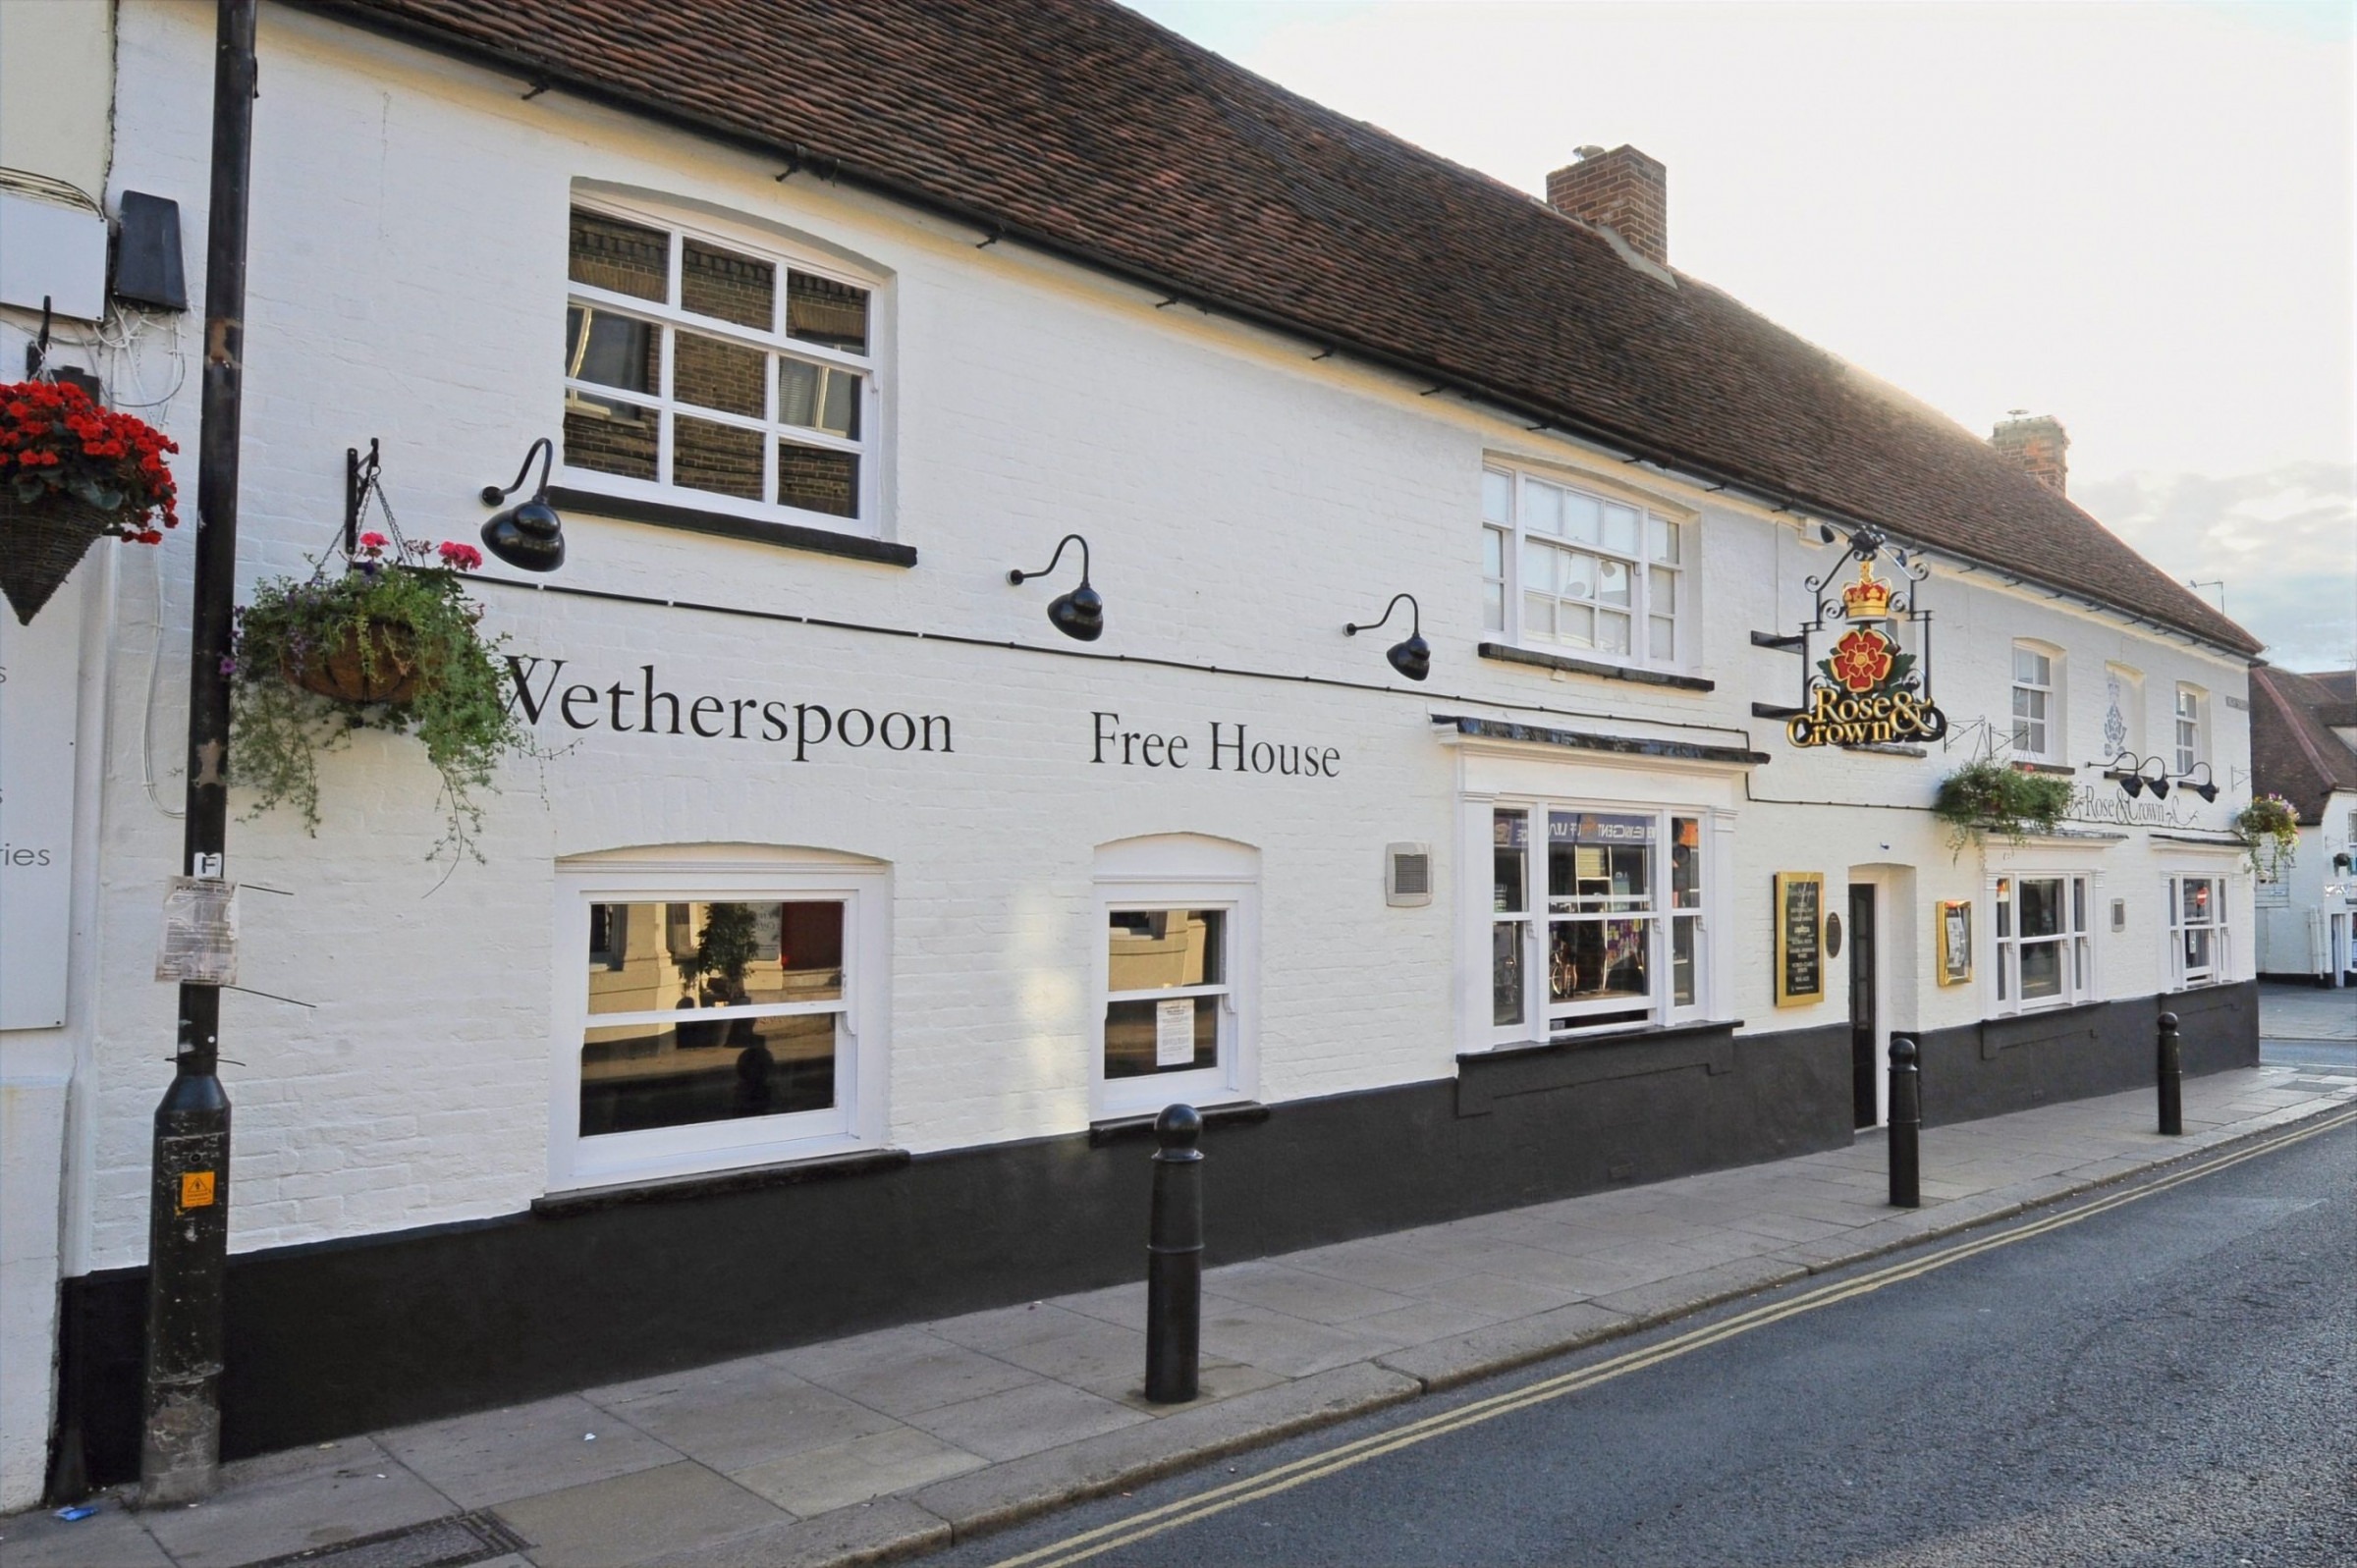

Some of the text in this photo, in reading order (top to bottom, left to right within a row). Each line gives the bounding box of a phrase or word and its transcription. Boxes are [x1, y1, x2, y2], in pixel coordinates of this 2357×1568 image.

[501, 655, 955, 762] Wetherspoon
[1786, 714, 1892, 748] Crown
[1814, 687, 1937, 734] Rose &
[1089, 711, 1341, 778] Free House
[2085, 784, 2114, 819] Rose
[2127, 792, 2165, 822] Crown
